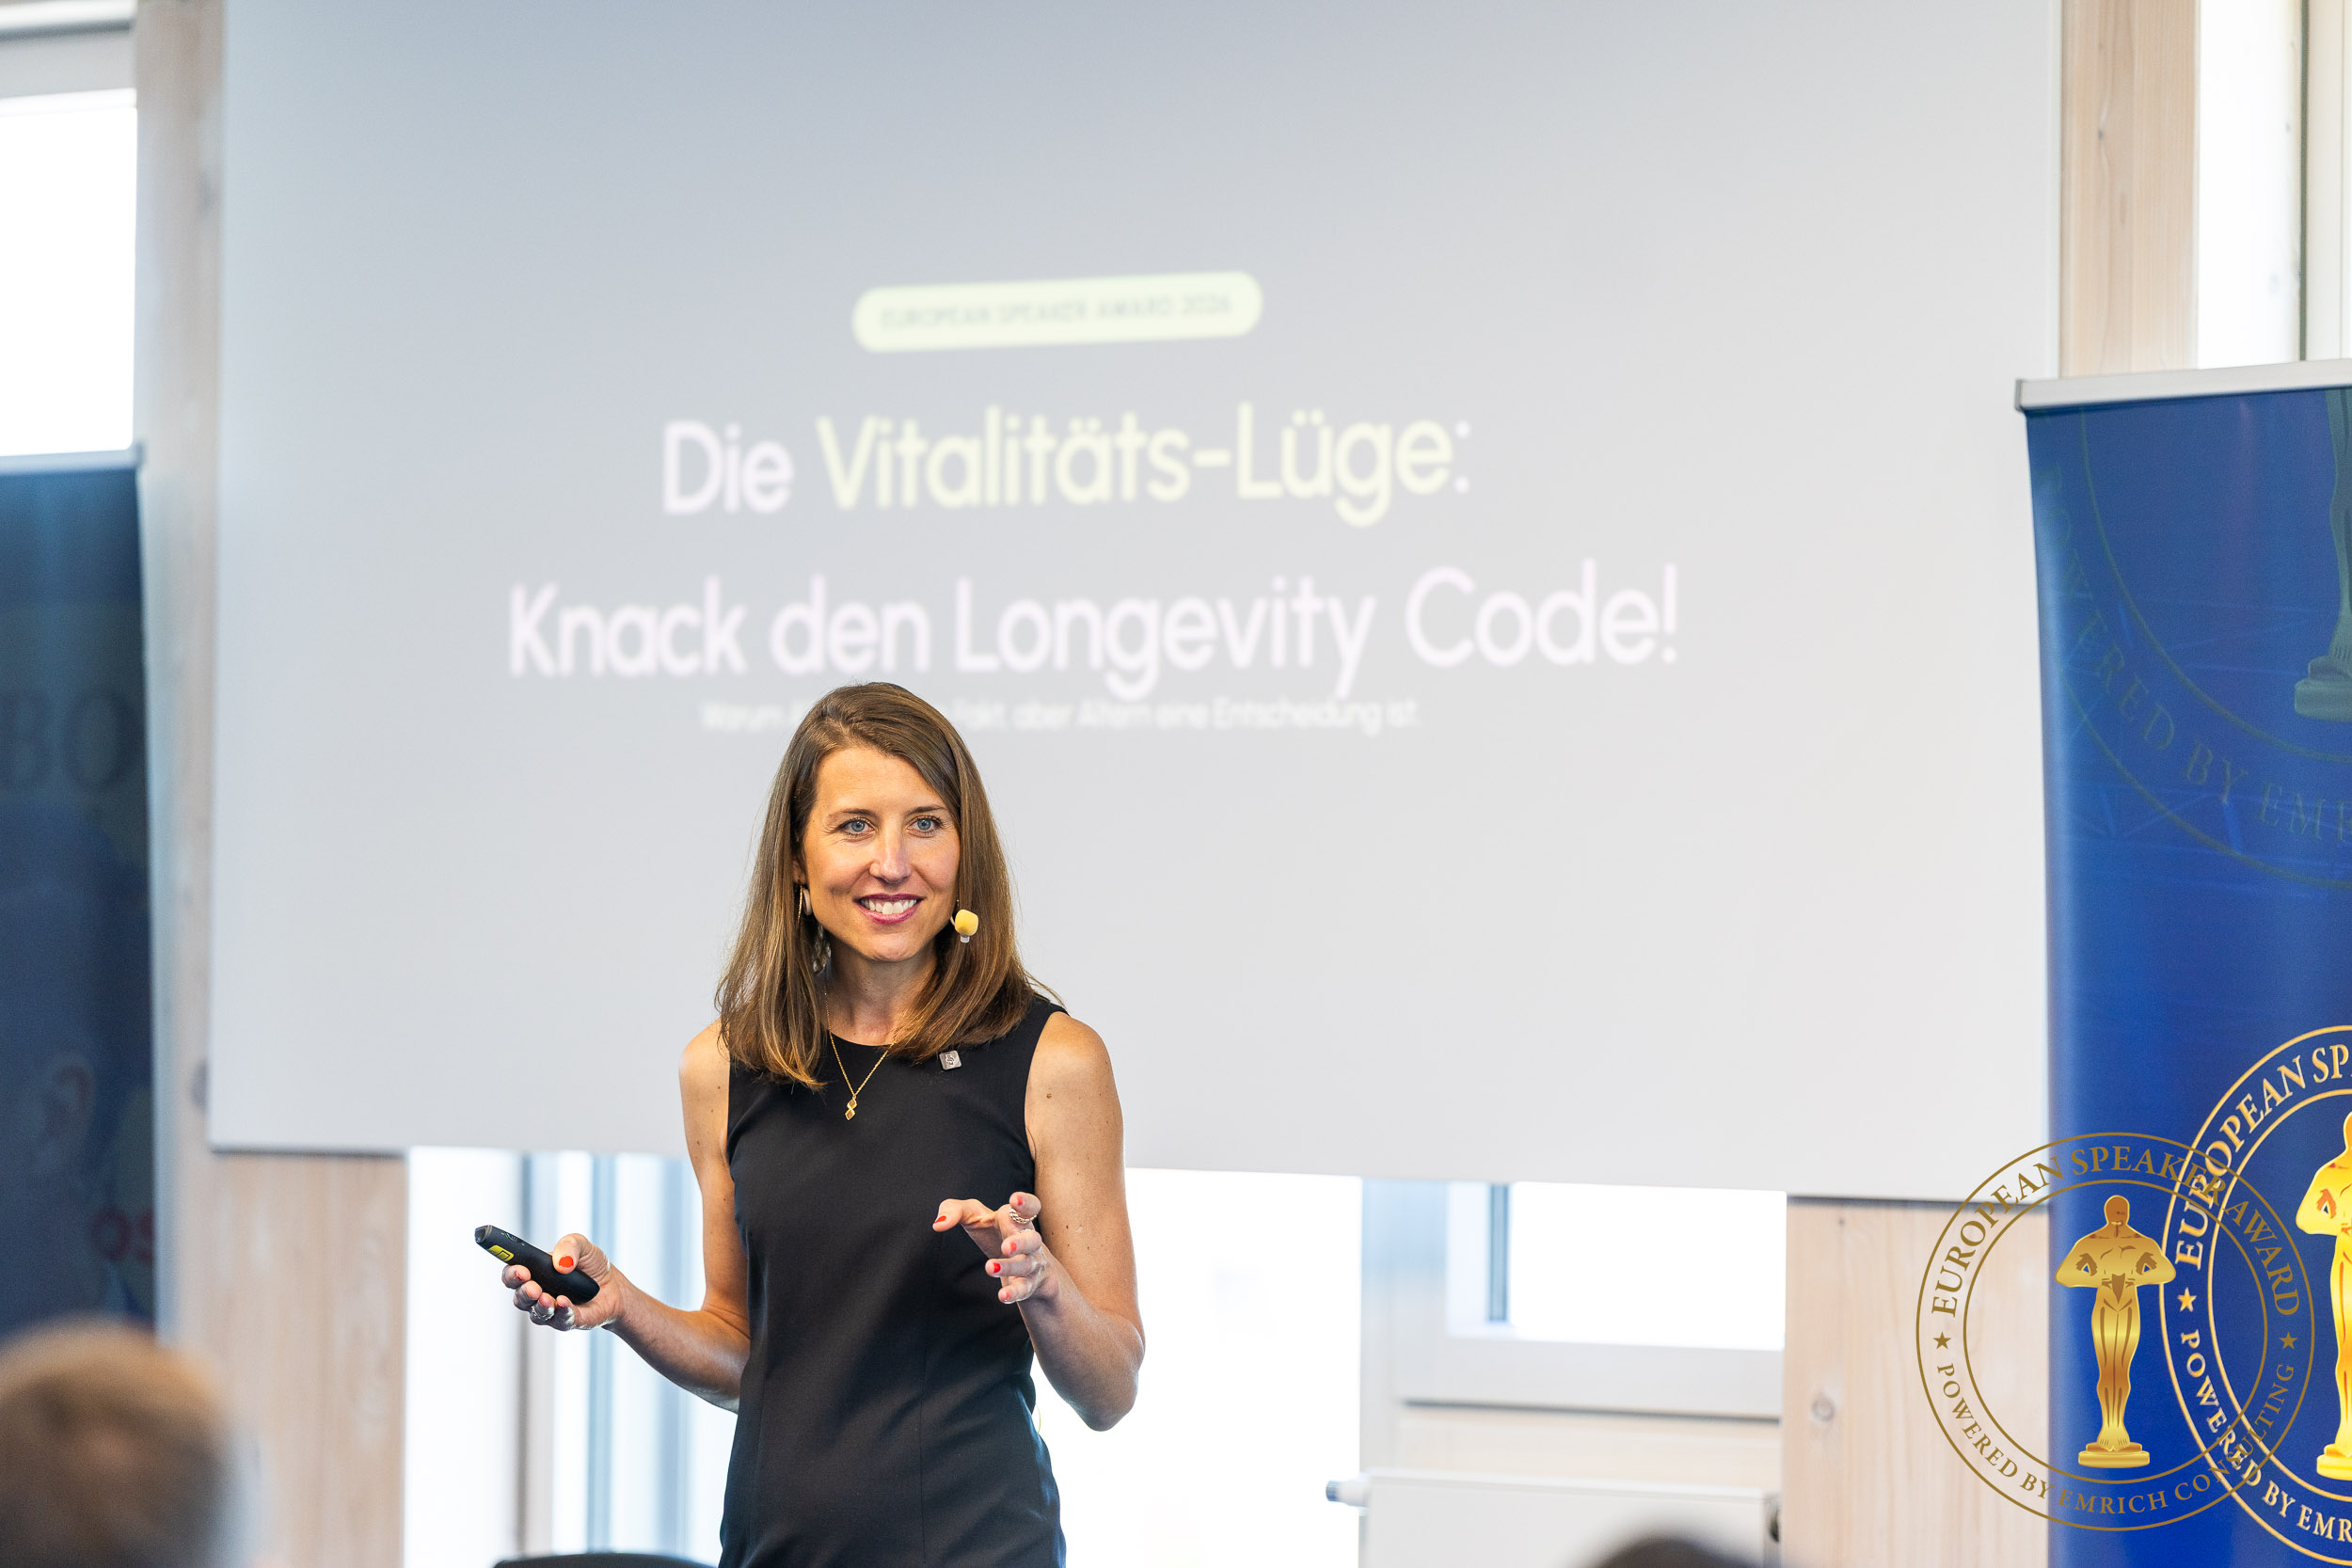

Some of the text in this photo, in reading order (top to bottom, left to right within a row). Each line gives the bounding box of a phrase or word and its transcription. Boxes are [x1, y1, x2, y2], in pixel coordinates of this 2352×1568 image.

[879, 304, 990, 331] EUROPEAN
[997, 298, 1088, 325] SPEAKER
[1095, 293, 1174, 320] AWARD
[662, 401, 1471, 528] Die Vitalitäts-Lüge:
[509, 557, 1678, 701] Knack den Longevity Code!
[1011, 697, 1073, 732] aber
[1211, 696, 1383, 736] Entscheidung
[2174, 1043, 2352, 1271] EUROPEAN SP
[2180, 1328, 2352, 1544] POWERED BY EMR
